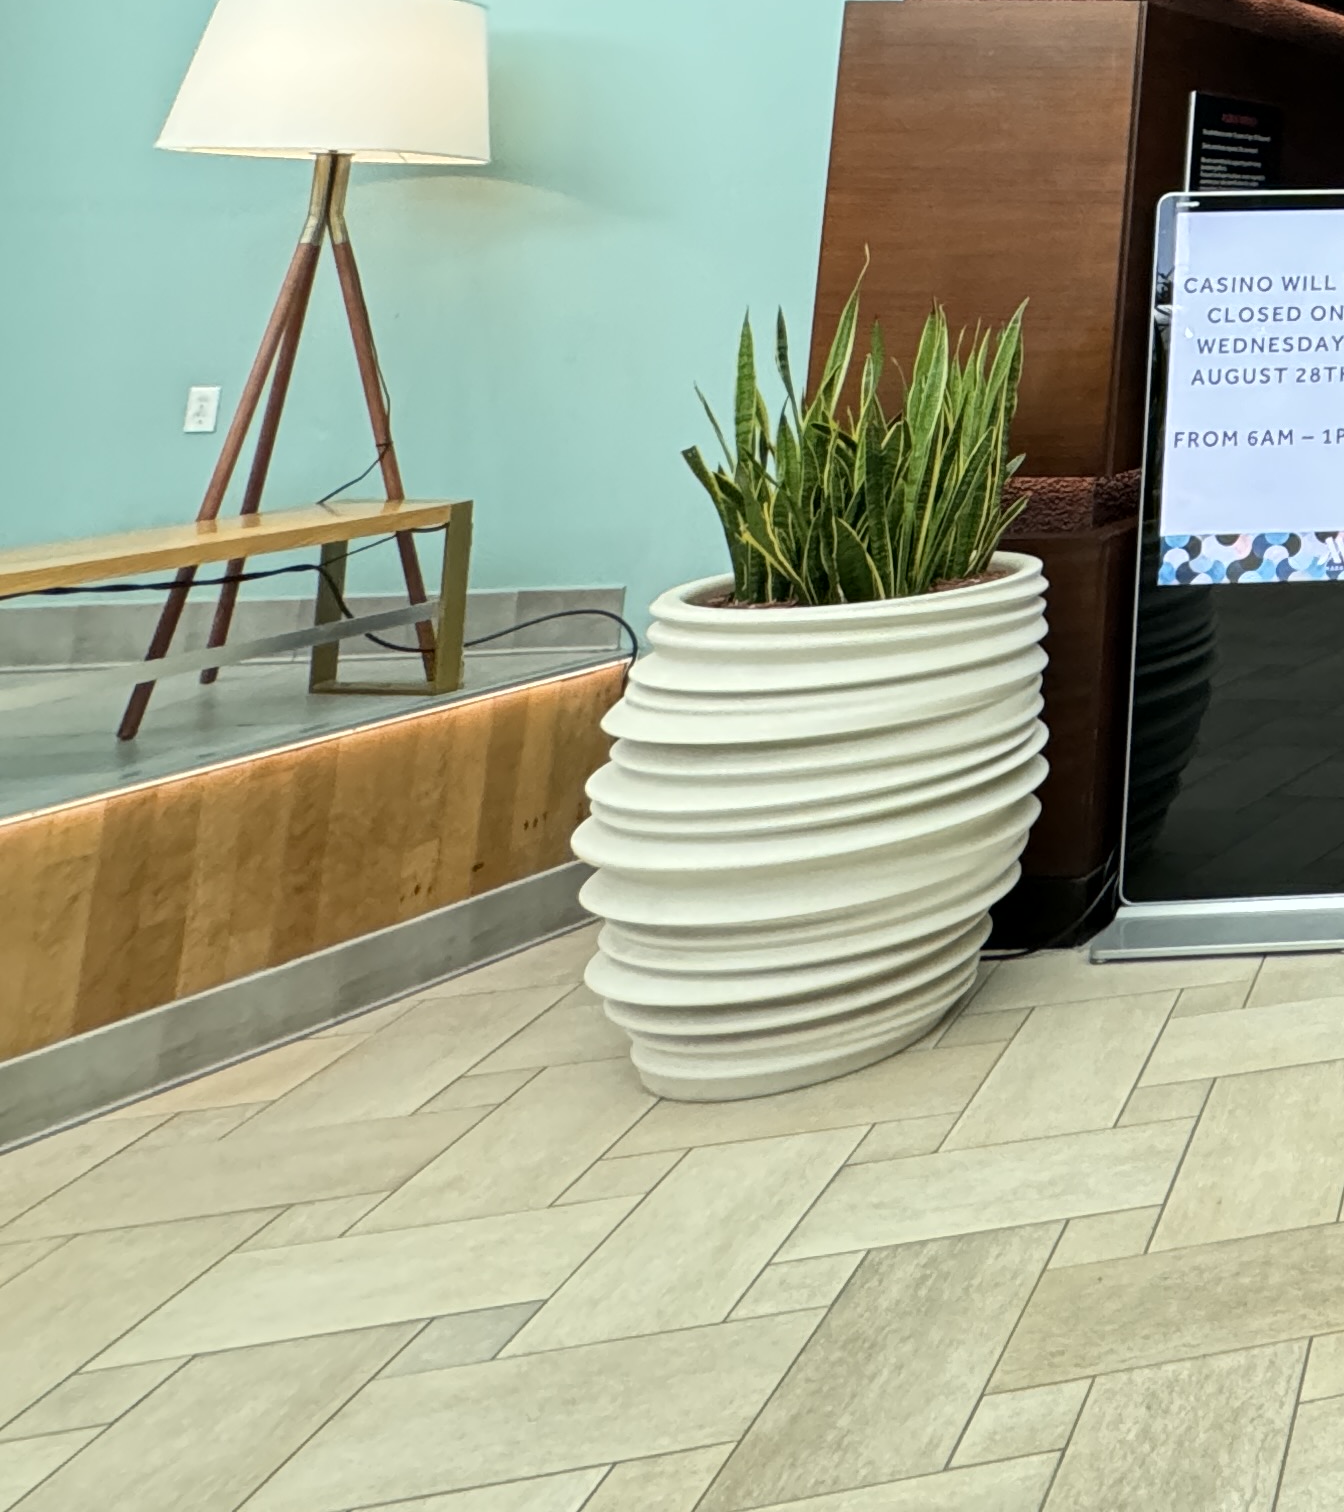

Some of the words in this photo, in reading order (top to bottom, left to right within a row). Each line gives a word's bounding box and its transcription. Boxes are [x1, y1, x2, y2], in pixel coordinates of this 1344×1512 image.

[1184, 276, 1273, 294] CASINO
[1281, 274, 1337, 292] WILL
[1207, 306, 1301, 324] CLOSED
[1310, 305, 1344, 321] ON
[1191, 367, 1288, 386] AUGUST
[1174, 430, 1238, 449] FROM
[1247, 429, 1294, 447] 6AM
